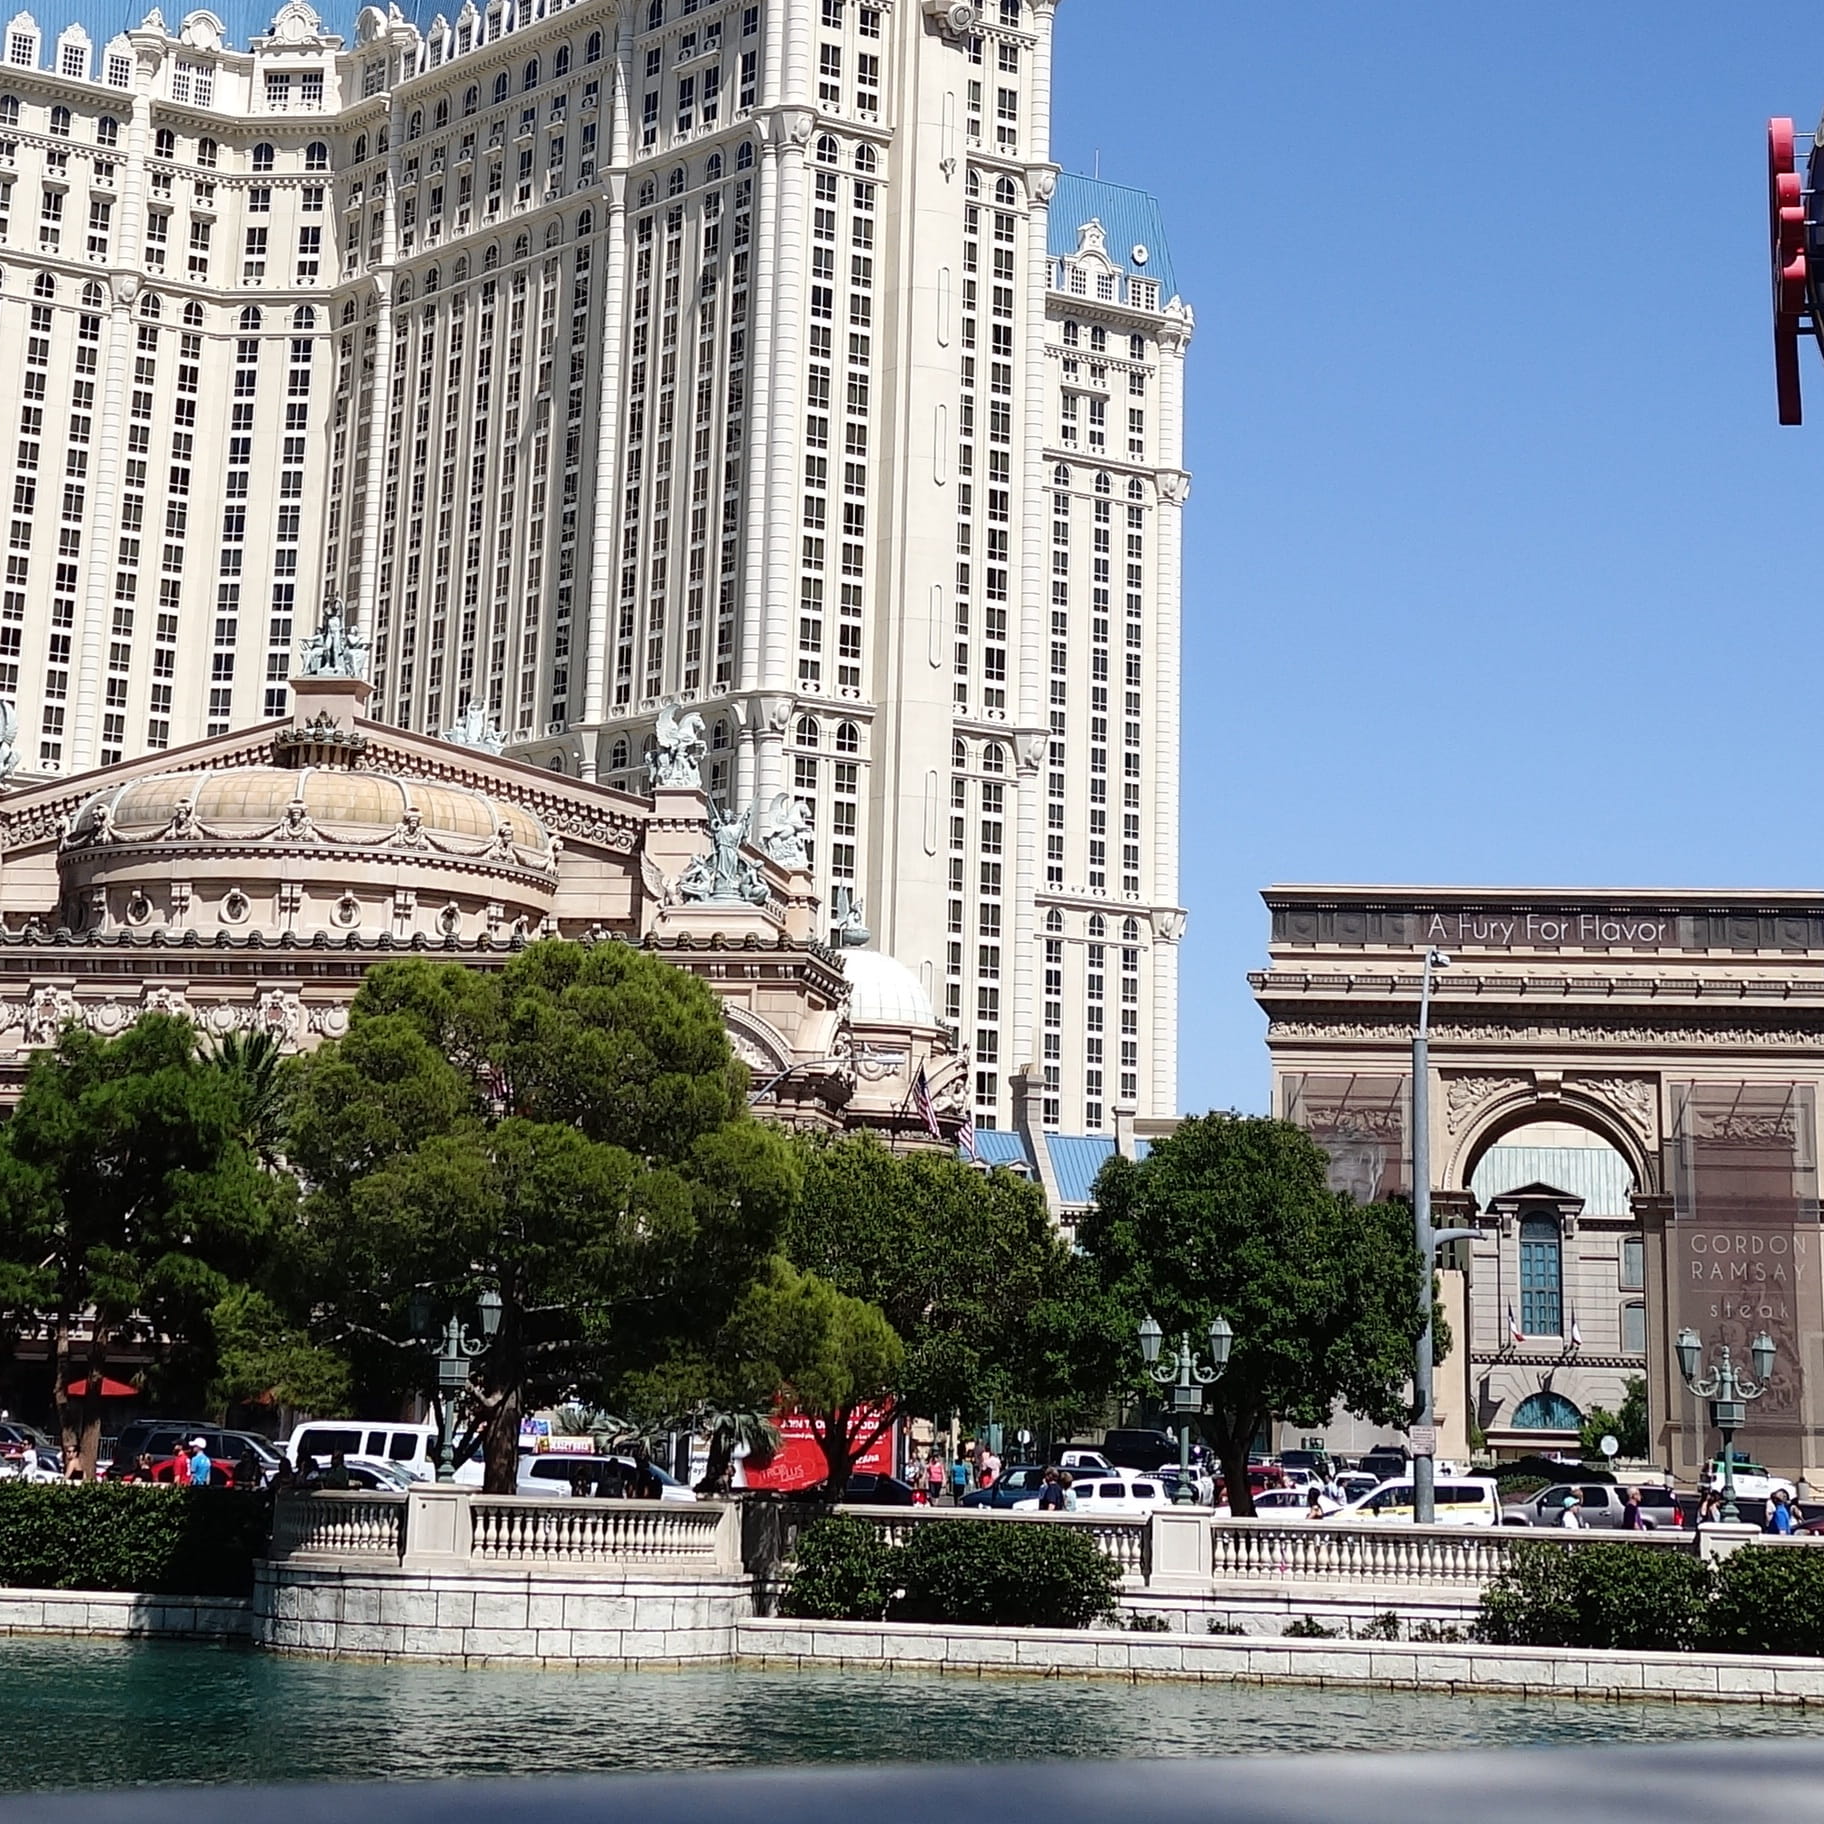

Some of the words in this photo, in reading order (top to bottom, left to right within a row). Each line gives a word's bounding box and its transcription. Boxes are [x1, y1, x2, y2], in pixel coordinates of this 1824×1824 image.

[1428, 913, 1448, 938] A
[1458, 913, 1514, 945] Fury
[1526, 913, 1569, 940] For
[1580, 914, 1667, 942] Flavor
[1690, 1234, 1806, 1255] GORDON
[1691, 1260, 1806, 1281] RAMSAY
[1709, 1301, 1789, 1318] steak
